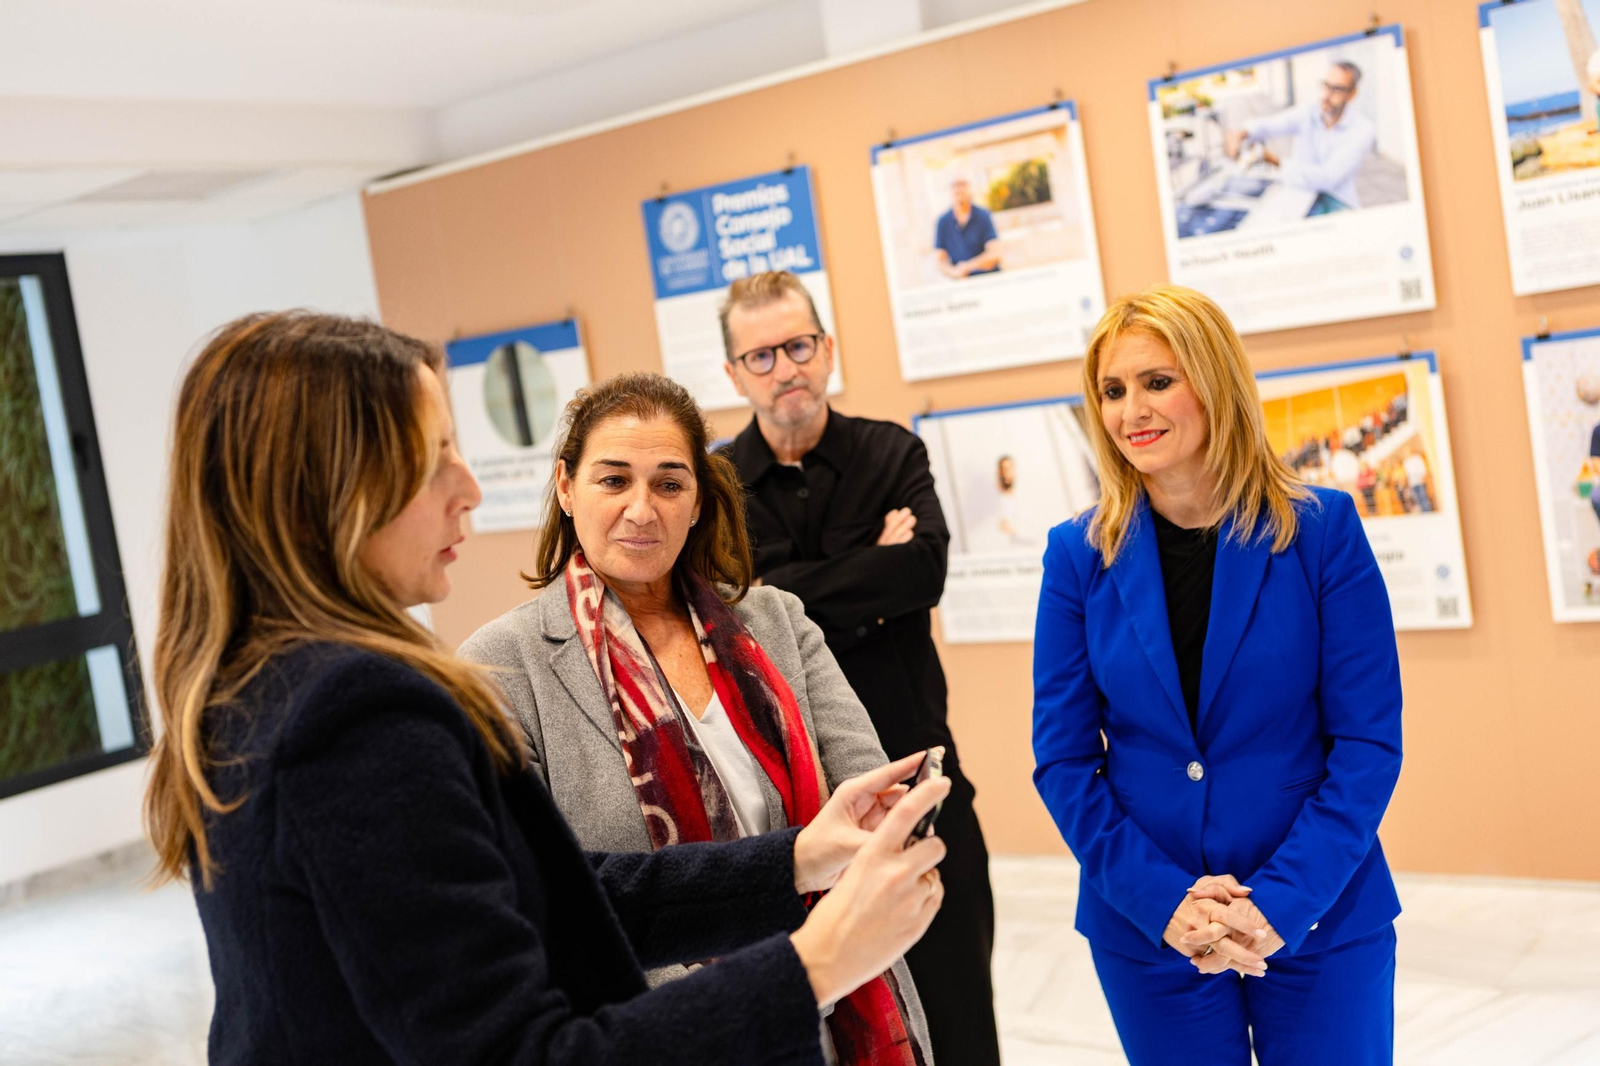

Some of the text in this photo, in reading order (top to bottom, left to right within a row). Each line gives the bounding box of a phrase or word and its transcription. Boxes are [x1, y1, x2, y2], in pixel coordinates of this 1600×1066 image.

[712, 183, 789, 216] Premios
[1518, 195, 1554, 211] Juan
[716, 205, 792, 233] Consejo
[718, 231, 777, 260] Social
[722, 257, 748, 281] de
[747, 251, 769, 275] la
[768, 244, 815, 272] UAL
